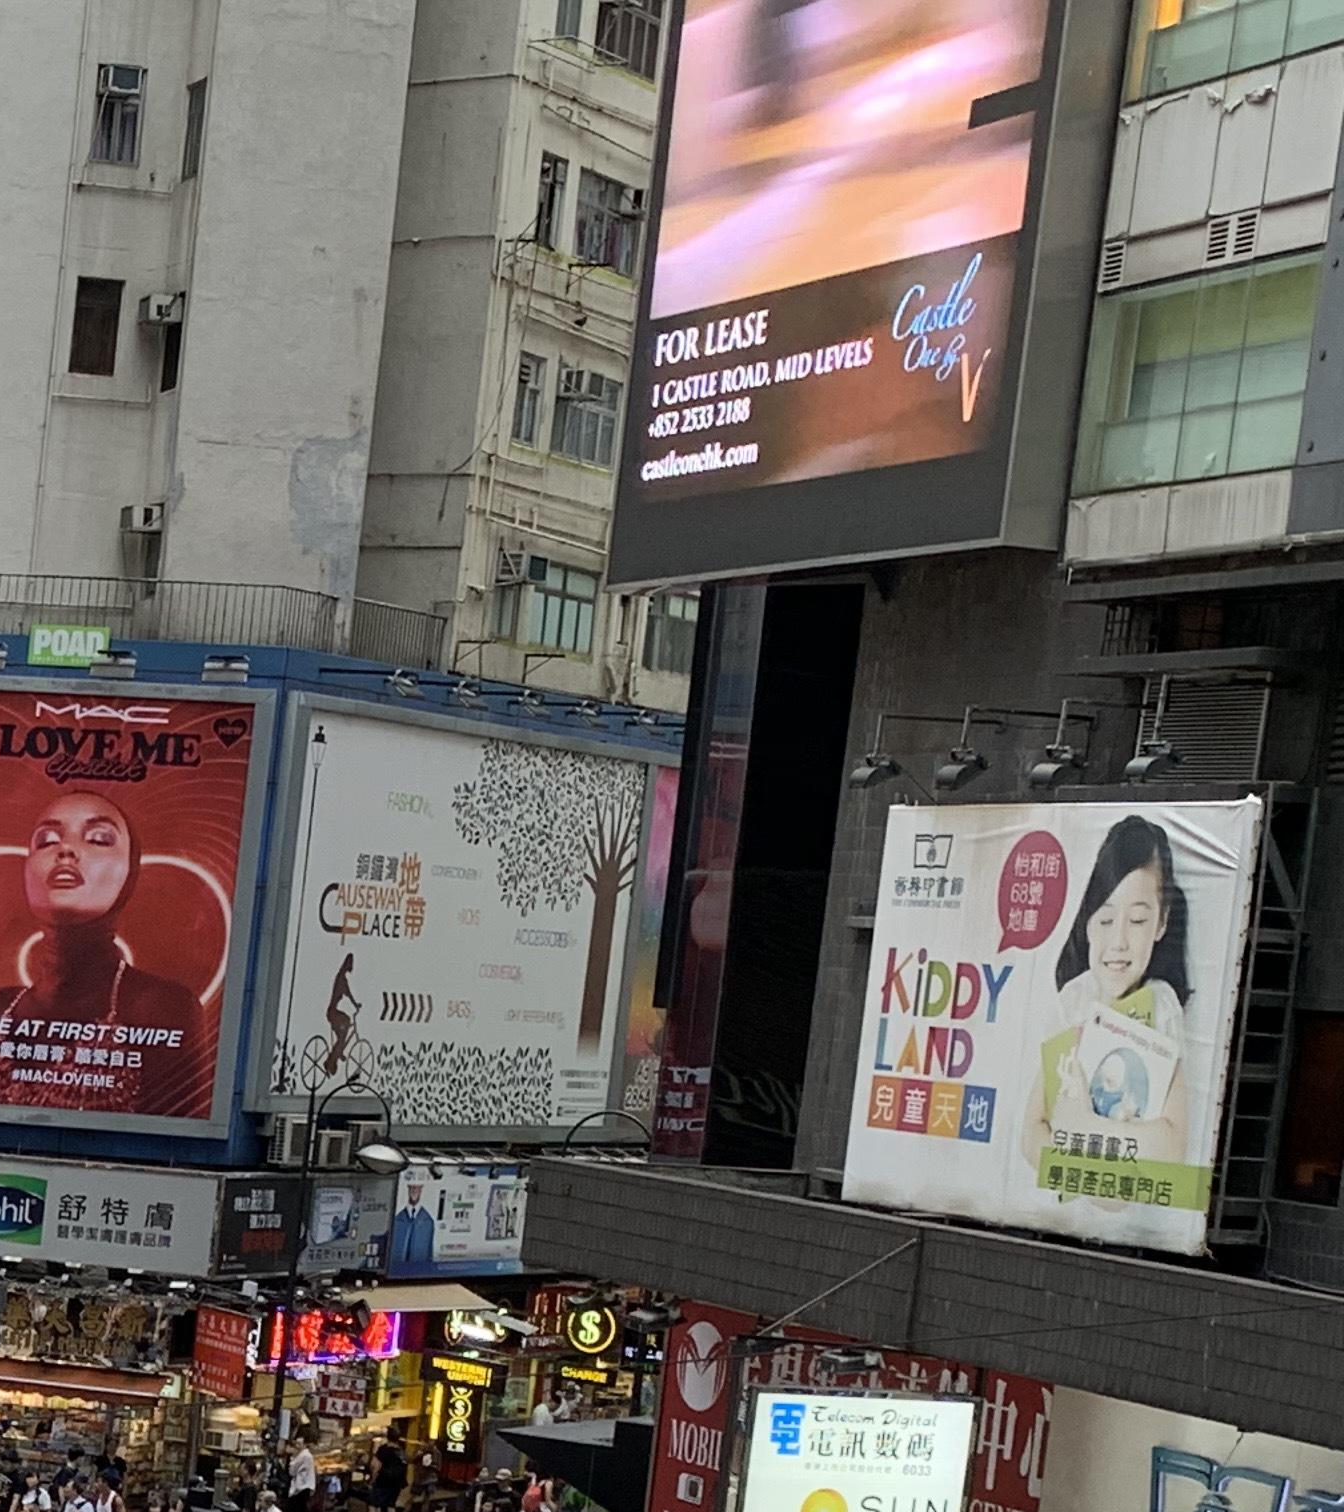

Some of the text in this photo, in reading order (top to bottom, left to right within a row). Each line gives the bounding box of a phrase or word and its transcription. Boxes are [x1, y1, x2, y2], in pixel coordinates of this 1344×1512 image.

[892, 253, 983, 341] Castle
[654, 309, 769, 367] FOR LEASE
[663, 371, 719, 405] CASTLE
[775, 353, 812, 382] MID
[815, 337, 874, 374] LEVELS
[648, 397, 752, 439] +852 2533 2188
[32, 628, 105, 657] POAD
[130, 731, 202, 768] ME
[1014, 852, 1062, 878] 怡和街
[319, 882, 406, 933] CAUSEWAY
[1010, 881, 1044, 906] 68號
[340, 910, 401, 946] PLACE
[14, 1019, 45, 1037] AT
[47, 1021, 111, 1043] FIRST
[113, 1026, 184, 1048] SWIPE
[874, 1016, 975, 1078] LAND
[11, 1068, 115, 1089] #MACLOVEME
[872, 1084, 990, 1133] 兒童天地
[1050, 1129, 1139, 1164] 兒童圖書及
[57, 1193, 174, 1231] 舒特膚
[812, 1405, 939, 1429] Telecom Digital
[808, 1429, 935, 1462] 電訊數碼
[902, 1464, 933, 1477] 6033
